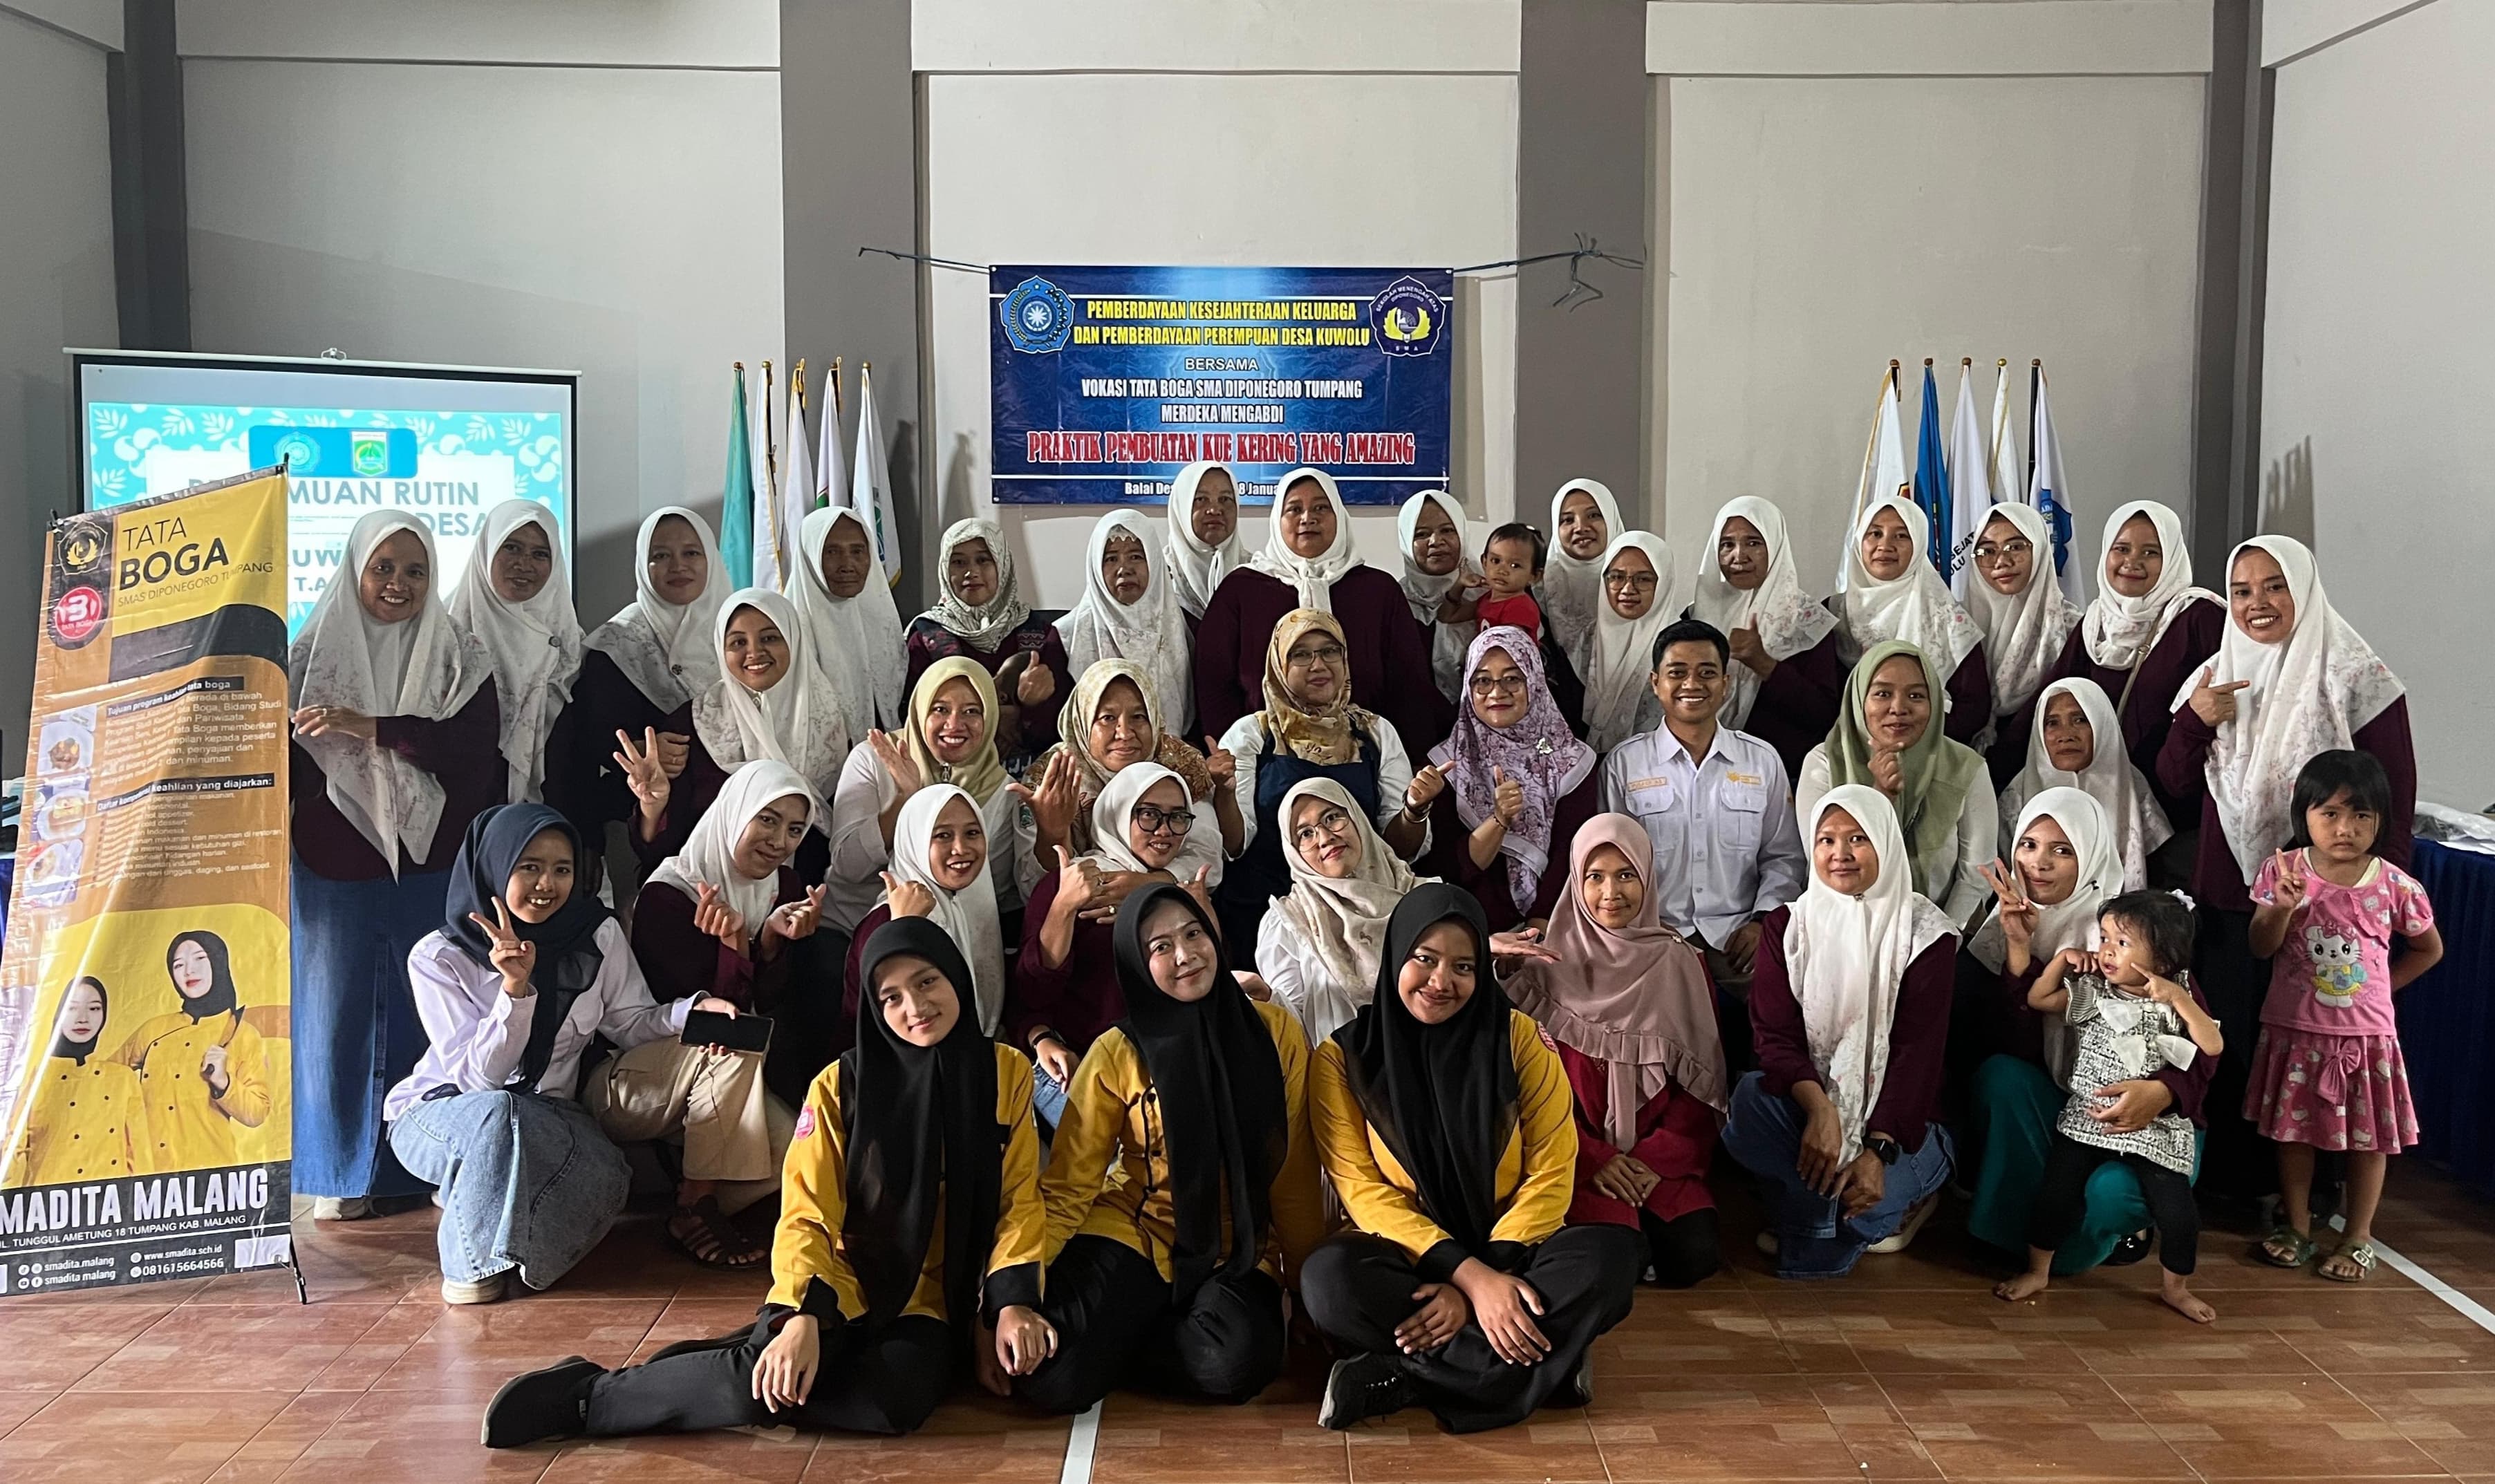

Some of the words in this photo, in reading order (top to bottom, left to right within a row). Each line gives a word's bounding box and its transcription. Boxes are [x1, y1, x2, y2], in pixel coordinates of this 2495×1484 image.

[1087, 300, 1186, 319] PEMBERDAYAAN
[1188, 301, 1289, 320] KESEJAHTERAAN
[1292, 301, 1357, 321] KELUARGA
[1074, 326, 1099, 344] DAN
[1102, 326, 1201, 345] PEMBERDAYAAN
[1204, 327, 1279, 346] PEREMPUAN
[1282, 327, 1314, 346] DESA
[1316, 328, 1370, 346] KUWOLU
[1184, 357, 1259, 370] BERSAMA
[1081, 378, 1128, 397] VOKASI
[1129, 379, 1158, 397] TATA
[1160, 379, 1194, 397] BOGA
[1195, 379, 1223, 398] SMA
[1225, 379, 1302, 398] DIPONEGORO
[1304, 380, 1363, 398] TUMPANG
[1161, 404, 1219, 422] MERDEKA
[1221, 405, 1284, 423] MENGABDI
[1027, 431, 1103, 462] PRAKTIK
[1104, 431, 1198, 462] PEMBUATAN
[1201, 432, 1233, 462] KUE
[1235, 432, 1298, 464] KERING
[1299, 433, 1343, 464] YANG
[1345, 432, 1416, 464] AMAZING
[395, 481, 479, 505] RUTIN
[1124, 482, 1154, 495] Balai
[122, 516, 187, 551] TATA
[119, 537, 229, 591] BOGA
[118, 592, 147, 607] SMAS
[148, 574, 218, 599] DIPONEGORO
[108, 704, 132, 716] Tujuan
[133, 697, 163, 711] program
[205, 681, 231, 690] boga
[231, 692, 263, 701] bawah
[223, 702, 256, 712] Bidang
[259, 700, 282, 709] Studi
[195, 713, 247, 722] Pariwisata.
[193, 724, 218, 734] Boga
[221, 722, 277, 732] memberikan
[205, 733, 240, 744] kepada
[242, 731, 277, 742] peserta
[187, 744, 234, 755] penyajian
[236, 743, 254, 752] dan
[166, 757, 184, 765] dan
[186, 754, 232, 764] minuman.
[151, 782, 194, 793] keahlian
[196, 782, 221, 791] yang
[223, 778, 272, 789] diajarkan:
[133, 1168, 268, 1221] MALANG
[12, 1235, 61, 1247] TUNGGUL
[62, 1229, 112, 1242] AMETUNG
[115, 1228, 127, 1237] 18
[128, 1222, 177, 1235] TUMPANG
[204, 1215, 246, 1227] MALANG
[143, 1243, 222, 1261] www.smadita.sch.id
[44, 1257, 115, 1272] smadita.malang
[142, 1257, 224, 1276] 081615664566
[44, 1272, 80, 1285] smadita
[82, 1270, 116, 1280] malang
